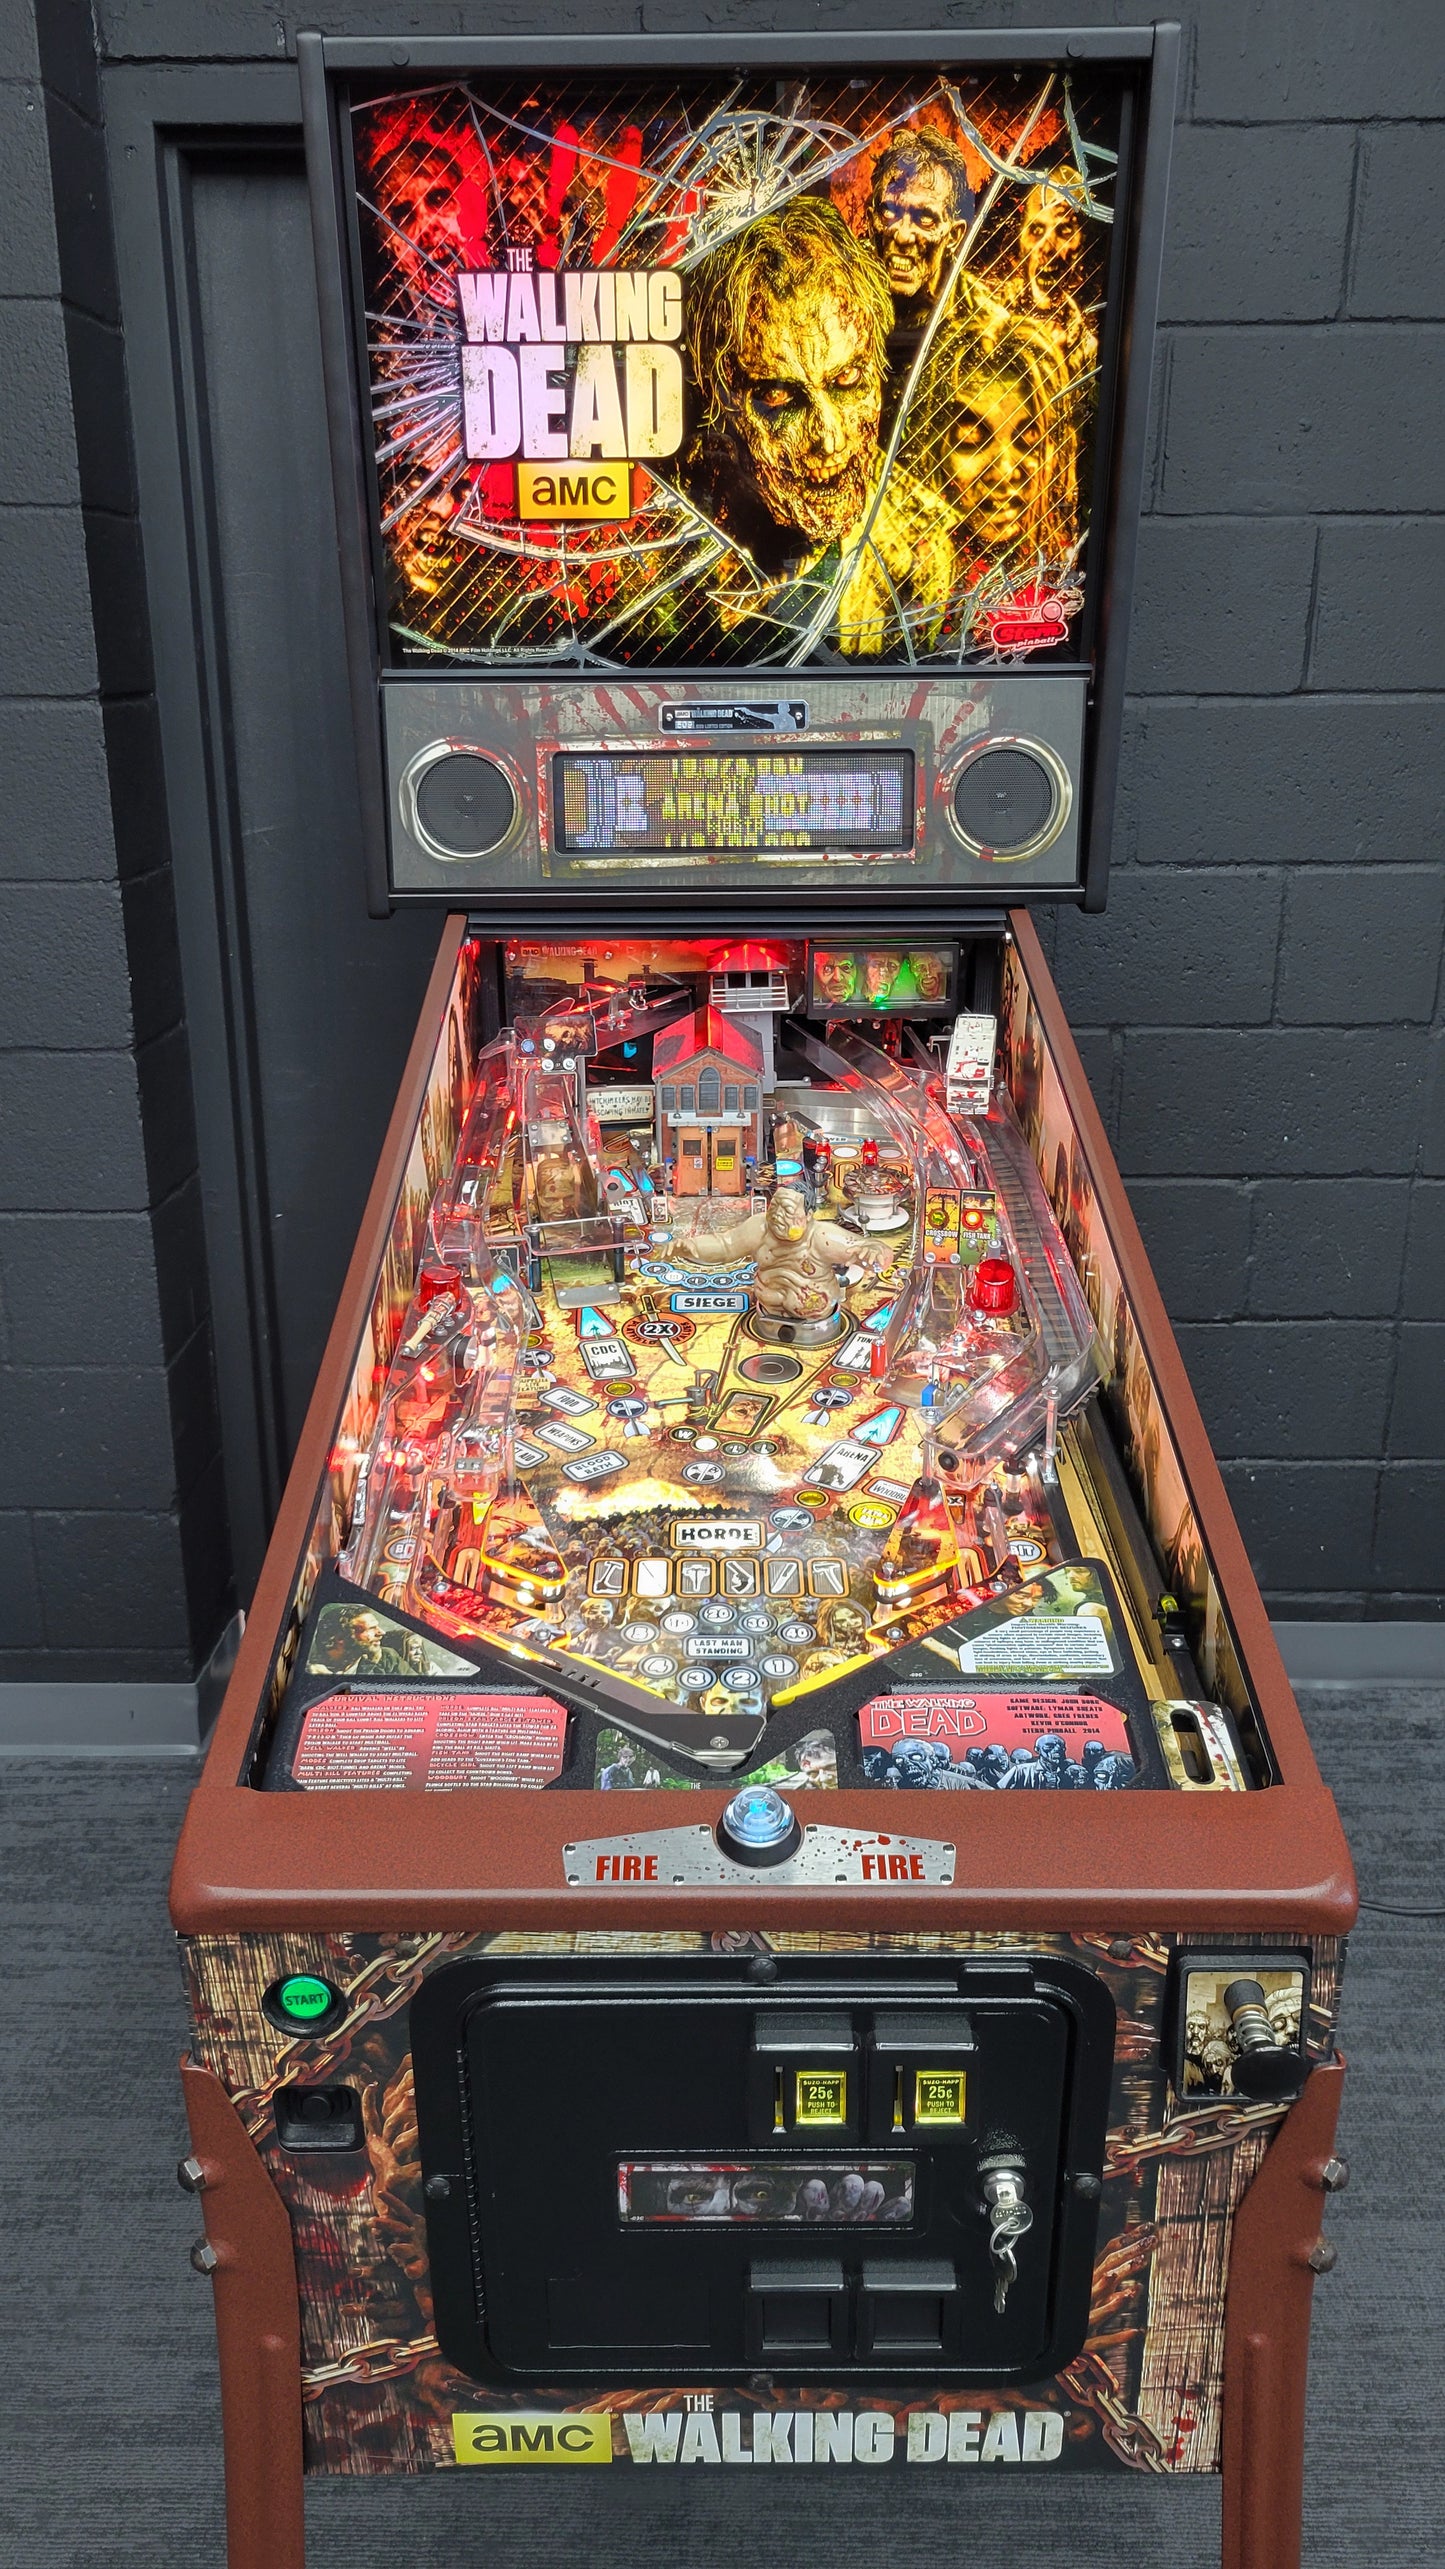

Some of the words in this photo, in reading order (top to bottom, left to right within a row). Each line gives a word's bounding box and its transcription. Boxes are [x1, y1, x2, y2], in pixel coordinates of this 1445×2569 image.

[507, 249, 532, 272] THE
[458, 271, 682, 342] WALKING
[461, 344, 683, 459] DEAD
[999, 625, 1063, 643] Stern
[1016, 637, 1055, 648] pinball
[684, 1297, 737, 1308] SIEGE
[645, 1323, 674, 1336] 2X
[591, 1344, 618, 1356] CDC
[557, 1395, 580, 1408] FOOD
[547, 1426, 582, 1446] WEAPONS
[519, 1452, 536, 1462] AID
[836, 1447, 870, 1463] ARENA
[574, 1455, 611, 1471] BLOOD
[584, 1461, 613, 1475] BATH
[681, 1528, 753, 1541] HORDE
[706, 1608, 732, 1620] 20
[746, 1617, 770, 1629] 30
[786, 1627, 807, 1639] 40
[648, 1658, 669, 1673] 4
[771, 1658, 786, 1673] 1
[687, 1671, 706, 1686] 3
[731, 1671, 752, 1686] 2
[329, 1695, 381, 1703] SURVIVAL
[869, 1698, 905, 1710] THE
[905, 1697, 976, 1709] WALKING
[871, 1707, 987, 1737] DEAD
[595, 1855, 659, 1881] FIRE
[861, 1854, 926, 1880] FIRE
[285, 1993, 324, 2007] START
[809, 2086, 834, 2100] 25¢
[929, 2086, 954, 2100] 25¢
[683, 2394, 714, 2413] THE
[623, 2412, 896, 2463] WALKING
[907, 2411, 1065, 2463] DEAD
